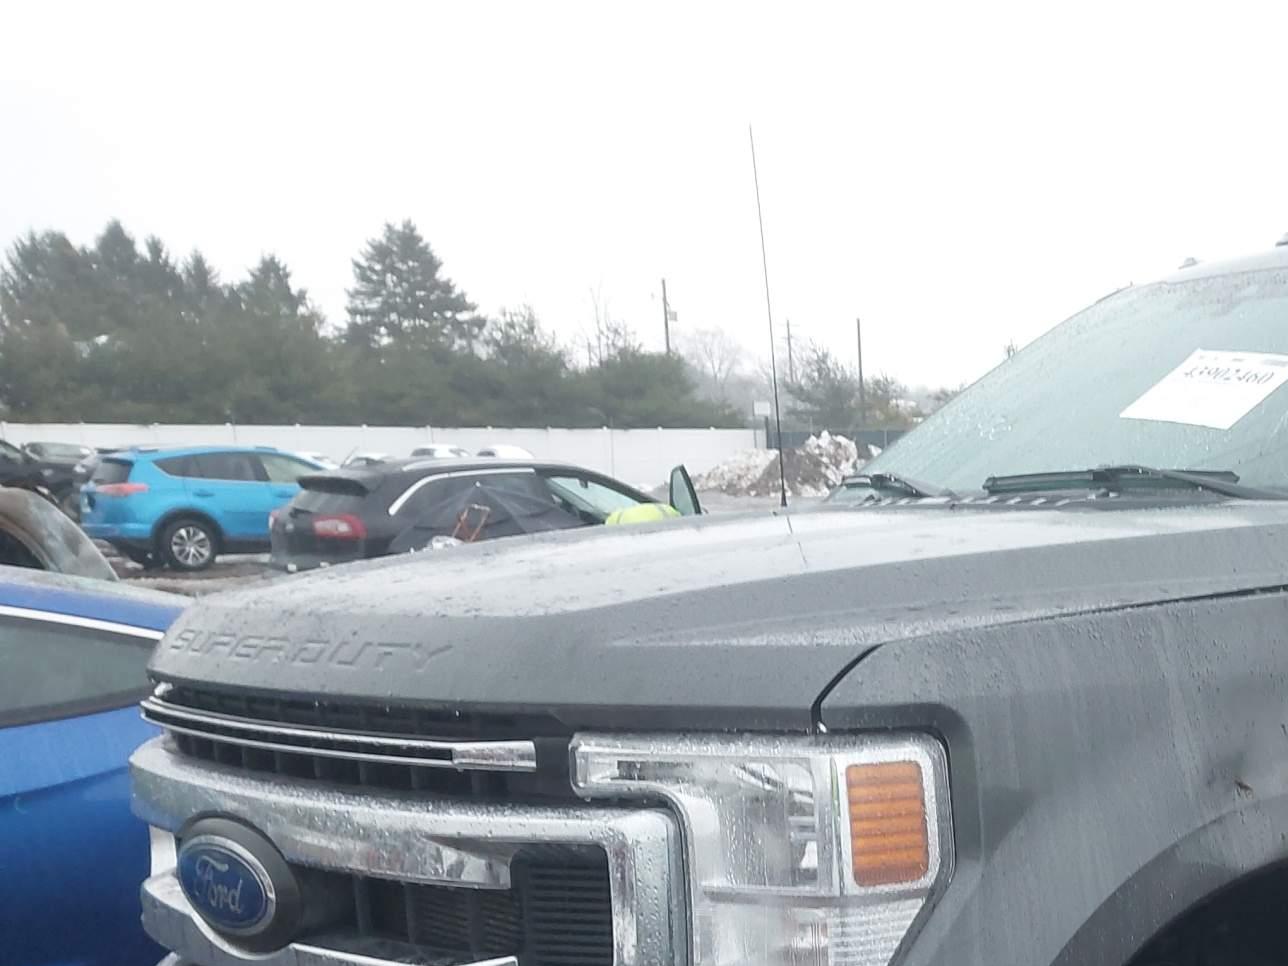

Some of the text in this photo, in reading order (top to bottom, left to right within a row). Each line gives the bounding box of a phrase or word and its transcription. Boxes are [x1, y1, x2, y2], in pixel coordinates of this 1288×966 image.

[171, 628, 454, 672] SUPER DUTY
[193, 855, 244, 914] Ford
